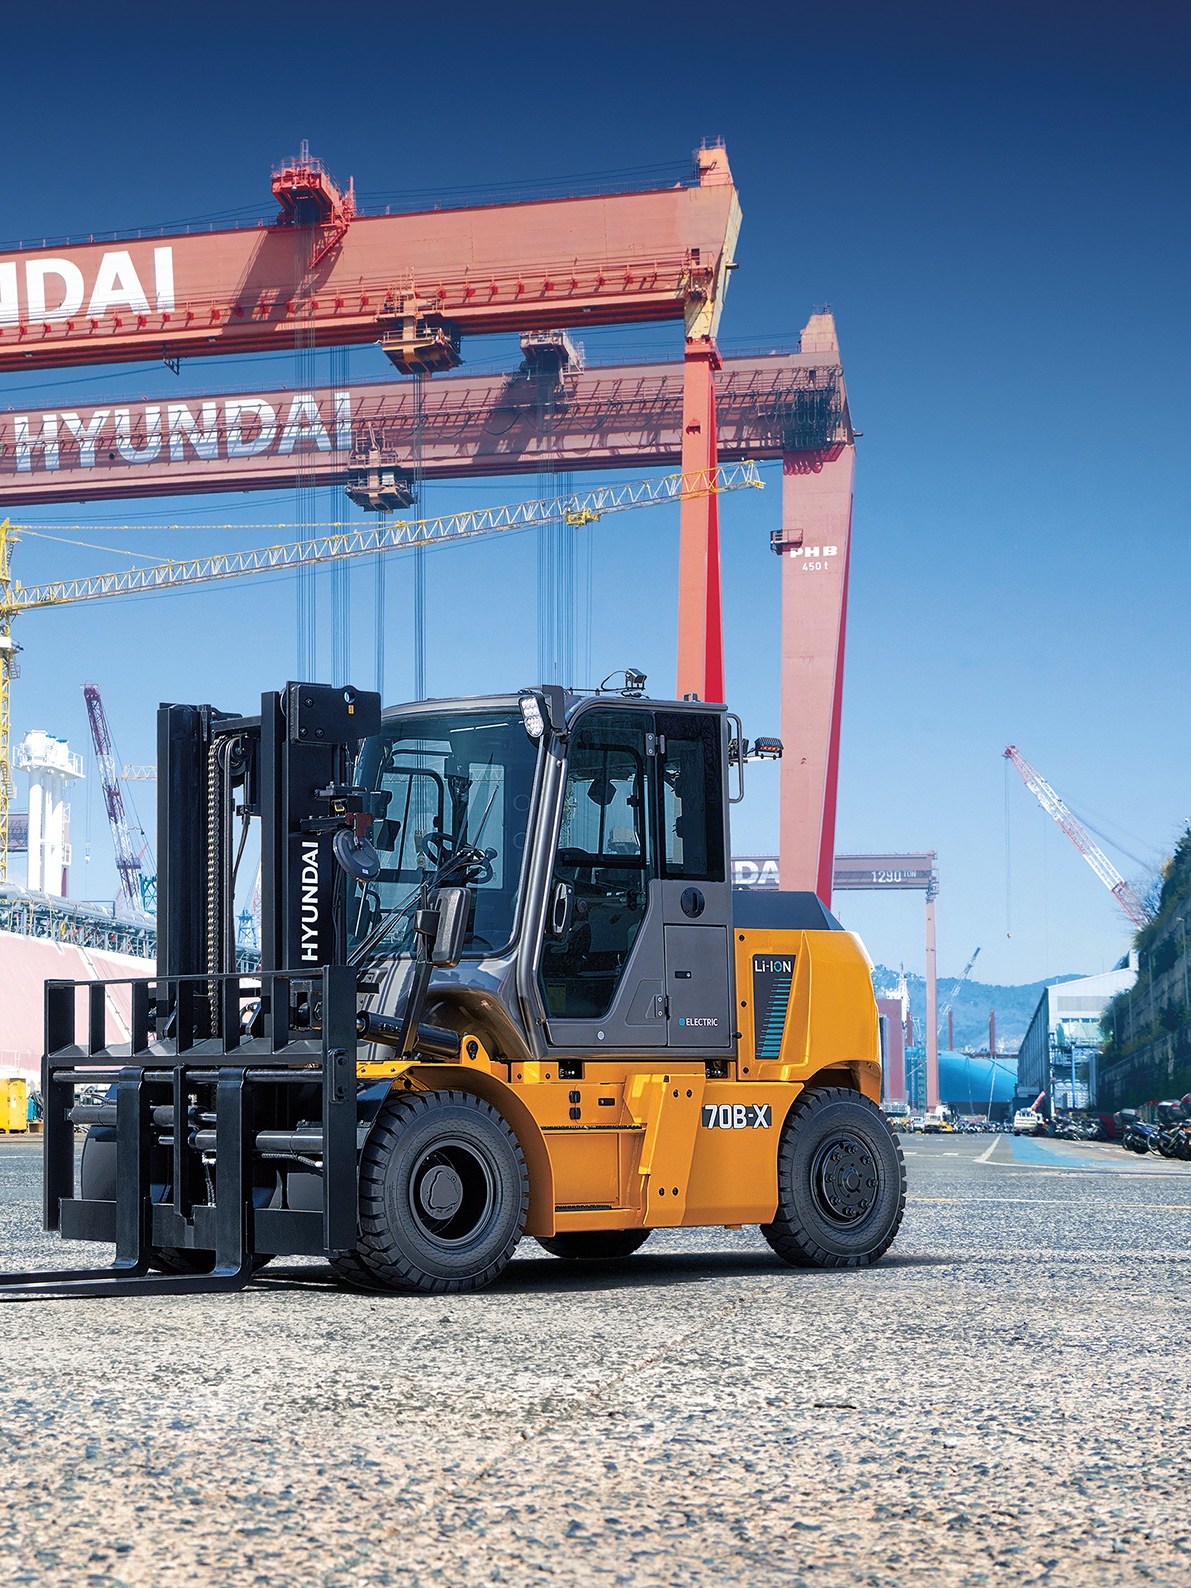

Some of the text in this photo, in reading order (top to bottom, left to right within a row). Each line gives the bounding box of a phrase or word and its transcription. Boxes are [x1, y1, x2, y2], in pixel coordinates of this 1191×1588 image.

[13, 391, 353, 472] HYUNDAI
[790, 545, 838, 558] PHB
[802, 561, 821, 571] 450
[734, 860, 780, 884] DA
[871, 870, 902, 883] 1290
[301, 841, 319, 961] HYUNDAI
[685, 1017, 719, 1027] ELECTRIC
[703, 1104, 770, 1130] 70B-X
